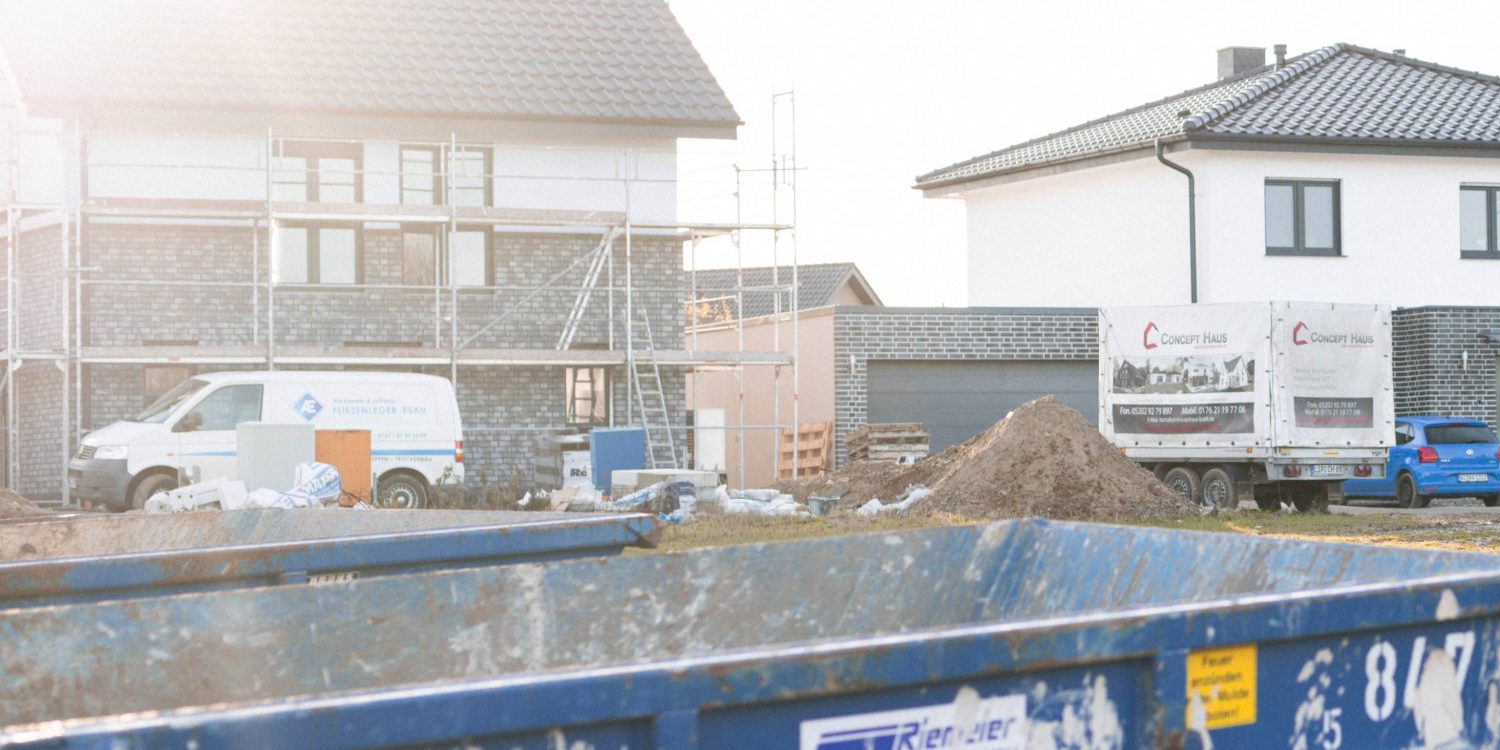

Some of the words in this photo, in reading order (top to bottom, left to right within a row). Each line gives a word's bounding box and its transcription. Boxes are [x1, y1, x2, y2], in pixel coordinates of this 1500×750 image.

[1161, 333, 1200, 345] CONCEPT
[1203, 331, 1228, 344] HAUS
[1310, 332, 1348, 344] CONCEPT
[1350, 332, 1374, 344] HAUS
[333, 406, 397, 415] FLIESENLEGER
[403, 406, 426, 415] ESAU
[1131, 406, 1147, 415] 05202
[1147, 406, 1155, 415] 92
[1198, 406, 1213, 414] 0176
[1213, 406, 1220, 414] 21
[1222, 405, 1229, 414] 19
[1230, 405, 1237, 413] 77
[1201, 654, 1234, 667] Feuer
